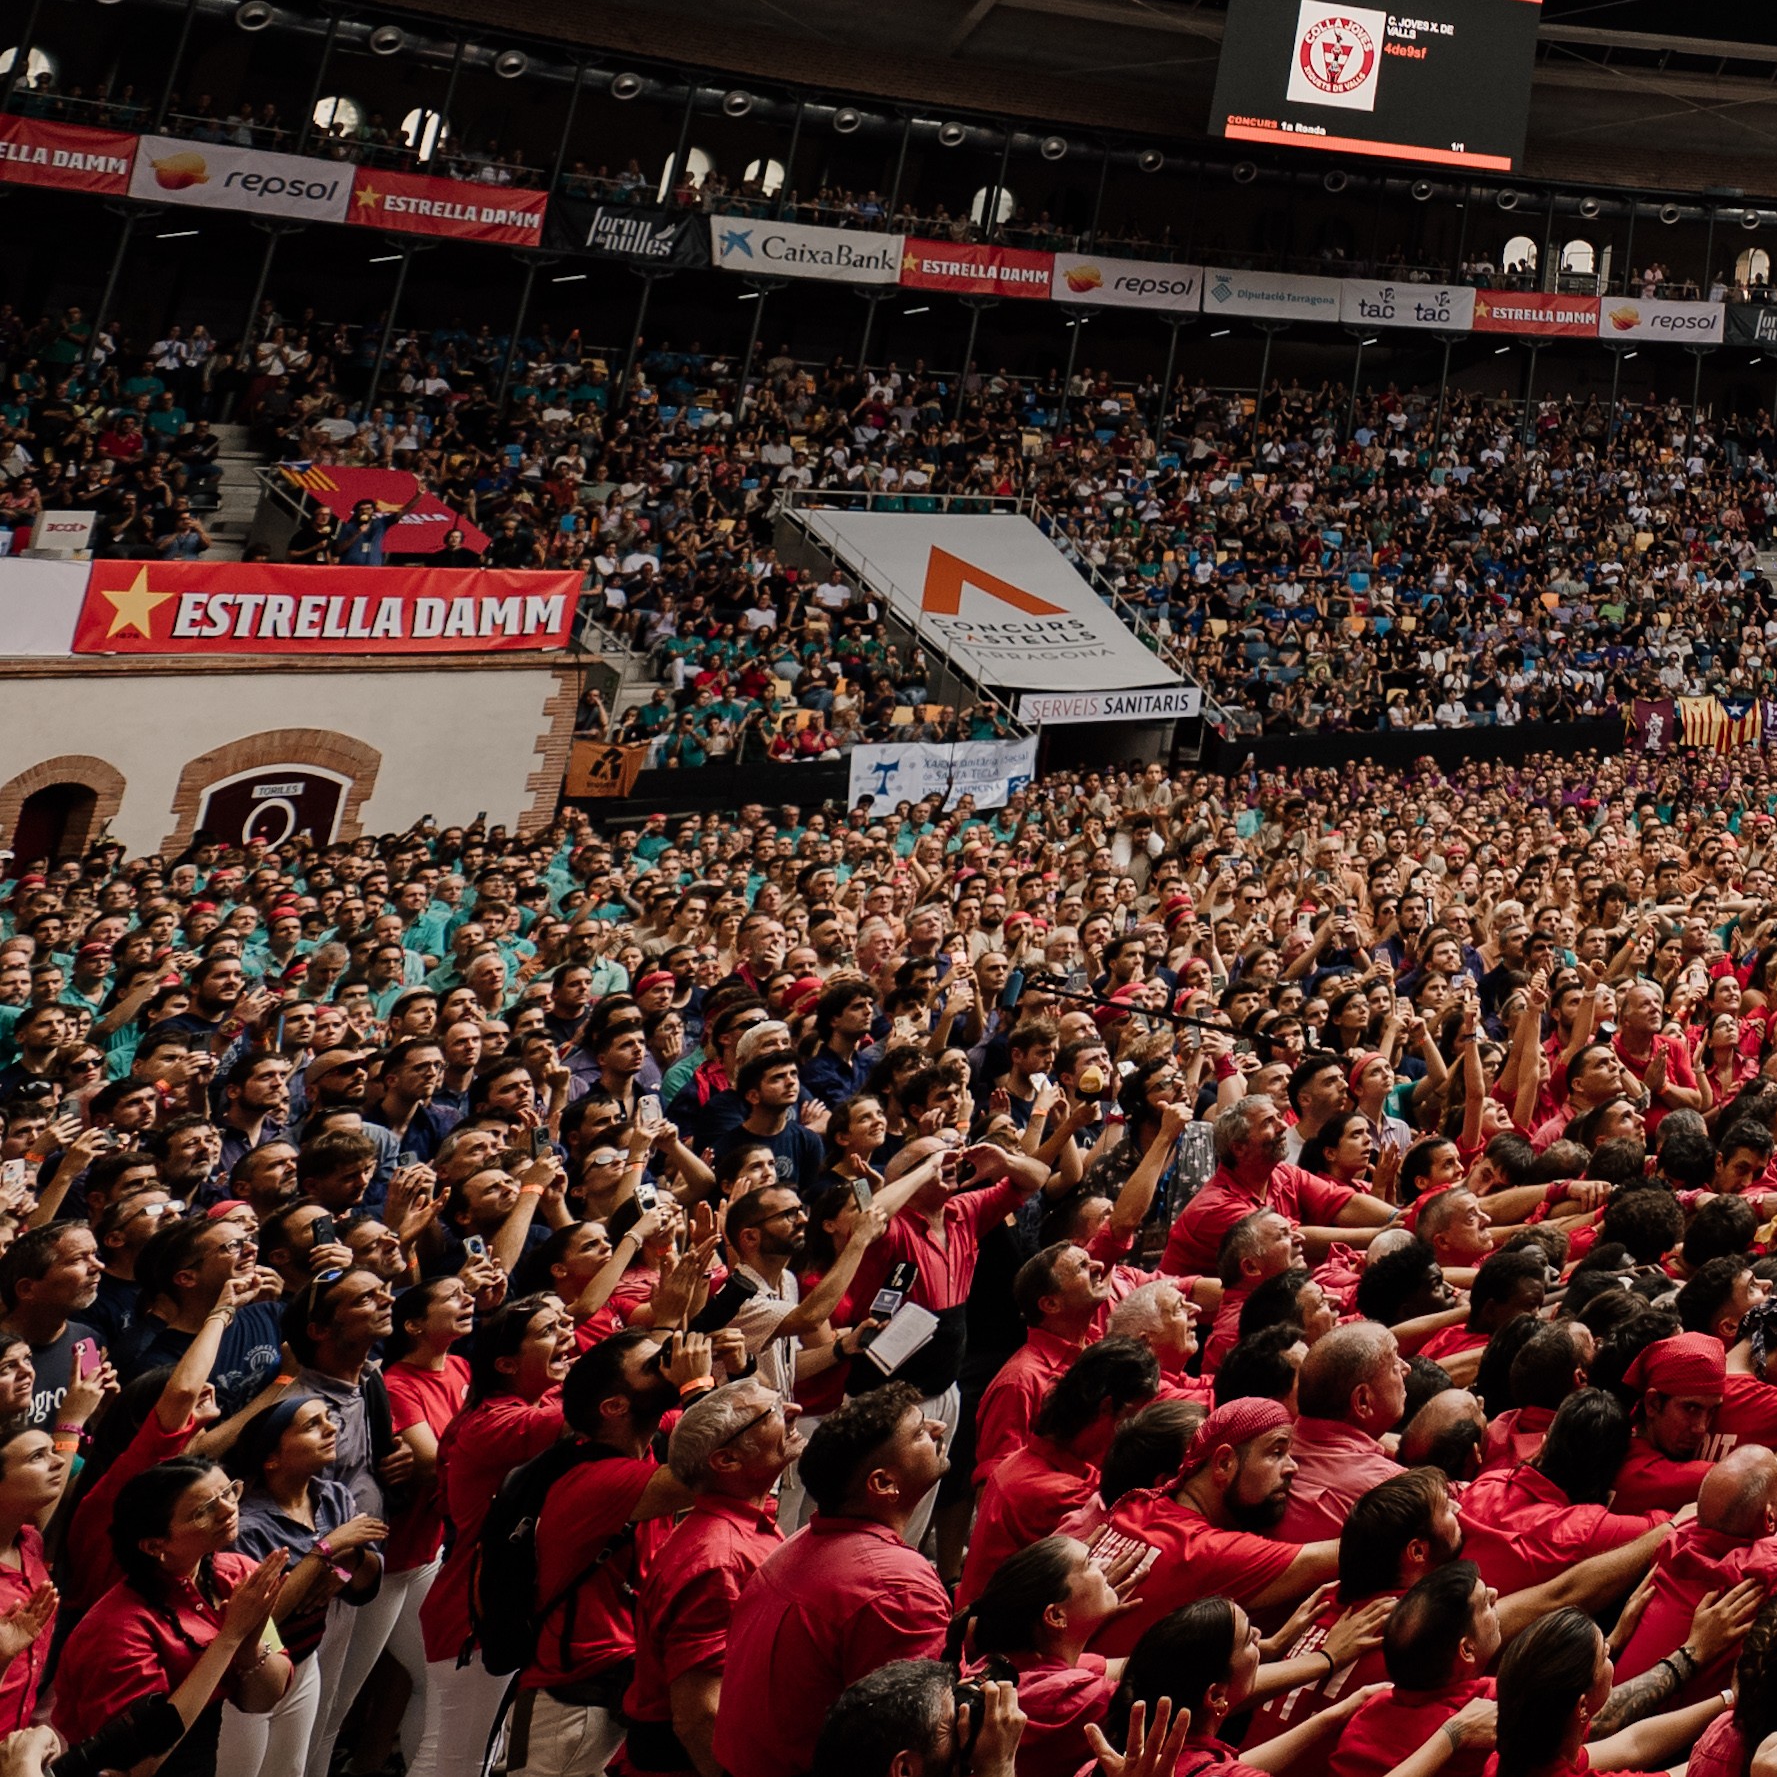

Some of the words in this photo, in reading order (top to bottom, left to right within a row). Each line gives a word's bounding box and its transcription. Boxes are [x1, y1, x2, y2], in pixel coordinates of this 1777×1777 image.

[1304, 18, 1342, 44] COLLA
[1344, 19, 1373, 52] JOVES
[1387, 26, 1417, 40] VALLS
[1399, 17, 1429, 31] JOVES
[1440, 23, 1455, 36] DE
[1332, 83, 1344, 93] DE
[1344, 73, 1367, 91] VALLS
[1227, 115, 1278, 129] CONCURS
[1295, 123, 1327, 135] Ronda
[1451, 142, 1465, 153] 1/1
[51, 148, 127, 175] DAMM
[223, 169, 339, 201] repsol
[384, 195, 481, 222] ESTRELLA
[480, 205, 541, 230] DAMM
[761, 235, 895, 271] CaixaBank
[922, 259, 998, 281] ESTRELLA
[999, 264, 1050, 285] DAMM
[1114, 273, 1193, 299] repsol
[1236, 287, 1286, 304] Diputació
[1286, 292, 1336, 307] Tarragona
[1358, 298, 1395, 320] tac
[1414, 302, 1451, 323] tac
[1492, 306, 1555, 323] ESTRELLA
[1555, 309, 1598, 326] DAMM
[1650, 311, 1717, 332] repsol
[171, 592, 405, 640] ESTRELLA
[411, 593, 567, 640] DAMM
[929, 618, 1085, 635] CONCURS
[942, 629, 1097, 646] CASTELLS
[963, 647, 1116, 663] TARRAGONA
[1030, 695, 1098, 719] SERVEIS
[1103, 693, 1190, 715] SANITARIS
[258, 783, 299, 796] TORILES
